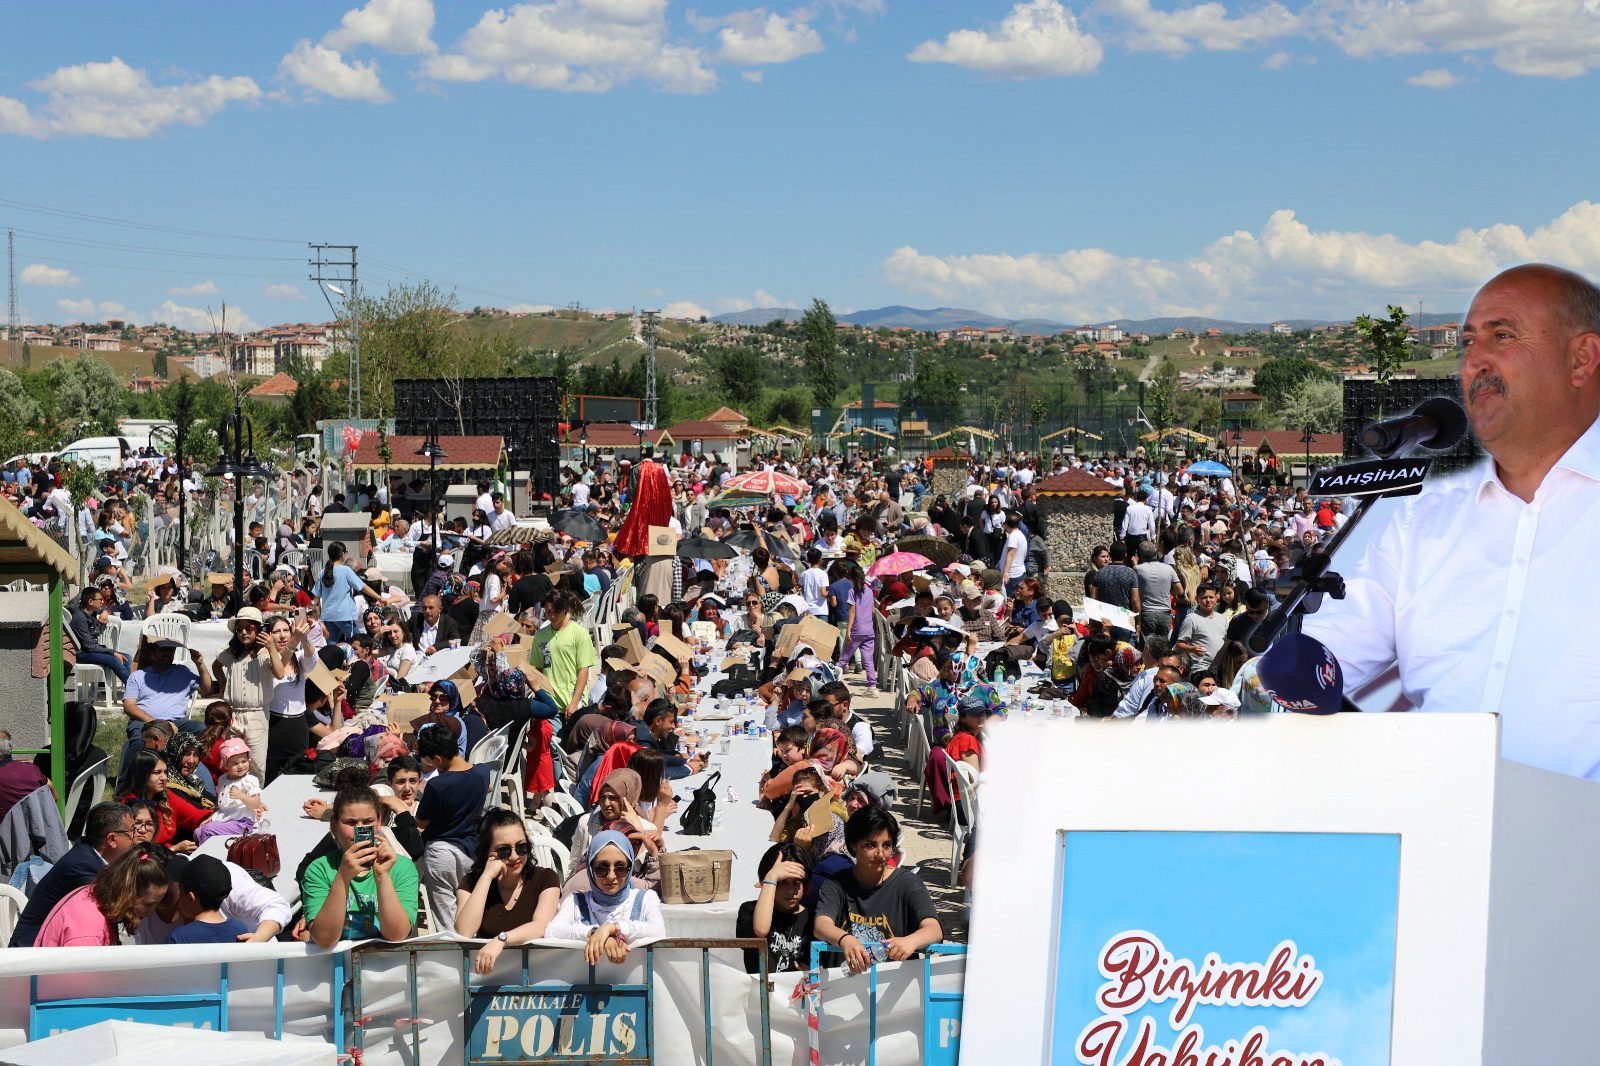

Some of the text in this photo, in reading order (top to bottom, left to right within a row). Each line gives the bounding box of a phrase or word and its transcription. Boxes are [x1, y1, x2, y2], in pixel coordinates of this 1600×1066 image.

[1319, 466, 1426, 488] YAHŞİHAN
[1101, 936, 1318, 1024] Bizimki
[488, 993, 583, 1010] KIRIKKALE
[481, 1000, 637, 1058] POLİS
